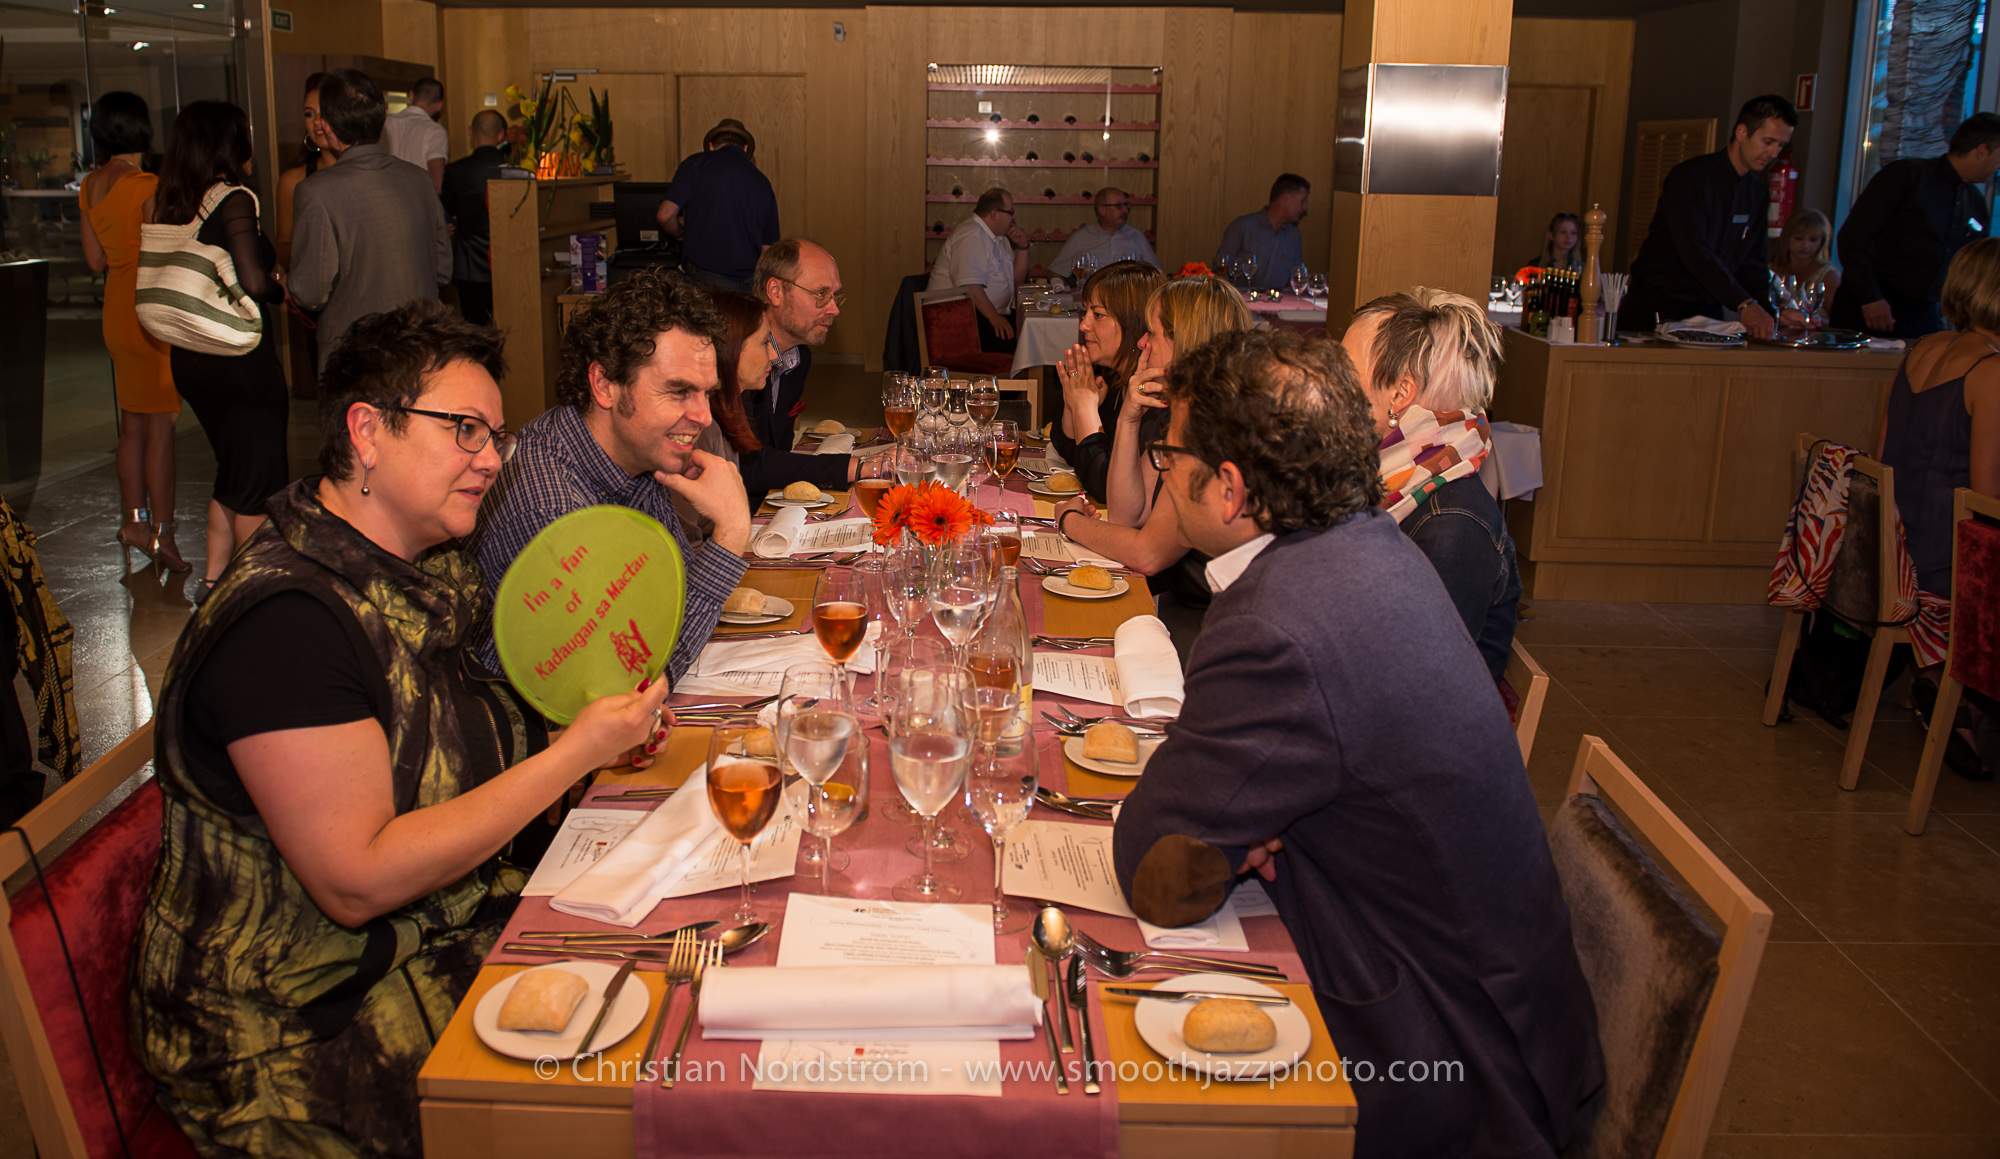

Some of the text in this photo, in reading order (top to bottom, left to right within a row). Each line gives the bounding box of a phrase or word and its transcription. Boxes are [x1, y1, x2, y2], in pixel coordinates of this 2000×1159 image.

[522, 544, 589, 613] I'm a fan
[565, 588, 582, 614] of
[534, 551, 650, 681] Kadaugan sa Mactan
